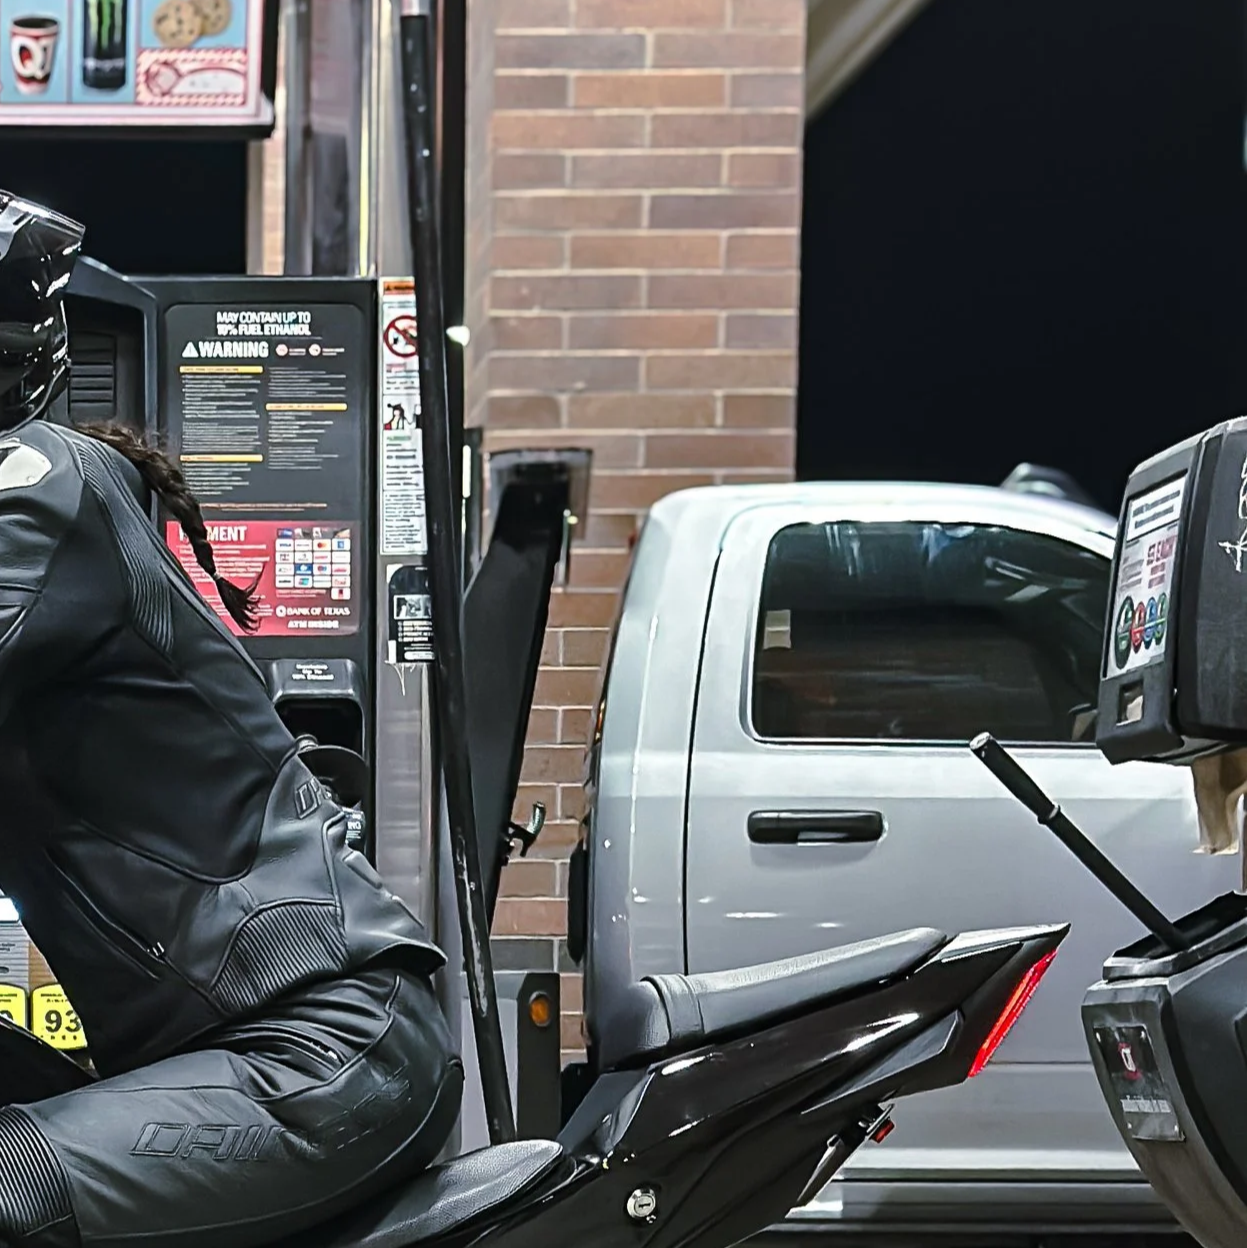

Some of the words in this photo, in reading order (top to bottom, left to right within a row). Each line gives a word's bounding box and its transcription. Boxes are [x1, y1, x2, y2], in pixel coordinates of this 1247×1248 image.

[217, 312, 238, 323] MAY
[239, 312, 282, 323] CONTAIN
[283, 312, 296, 323] UP
[297, 312, 311, 323] TO
[217, 324, 238, 336] 10%
[239, 324, 263, 335] FUEL
[264, 324, 311, 335] ETHANOL
[199, 341, 269, 358] WARNING
[287, 607, 310, 616] BANK
[311, 607, 322, 616] OF
[324, 607, 350, 616] TEXAS
[44, 1010, 81, 1033] 93
